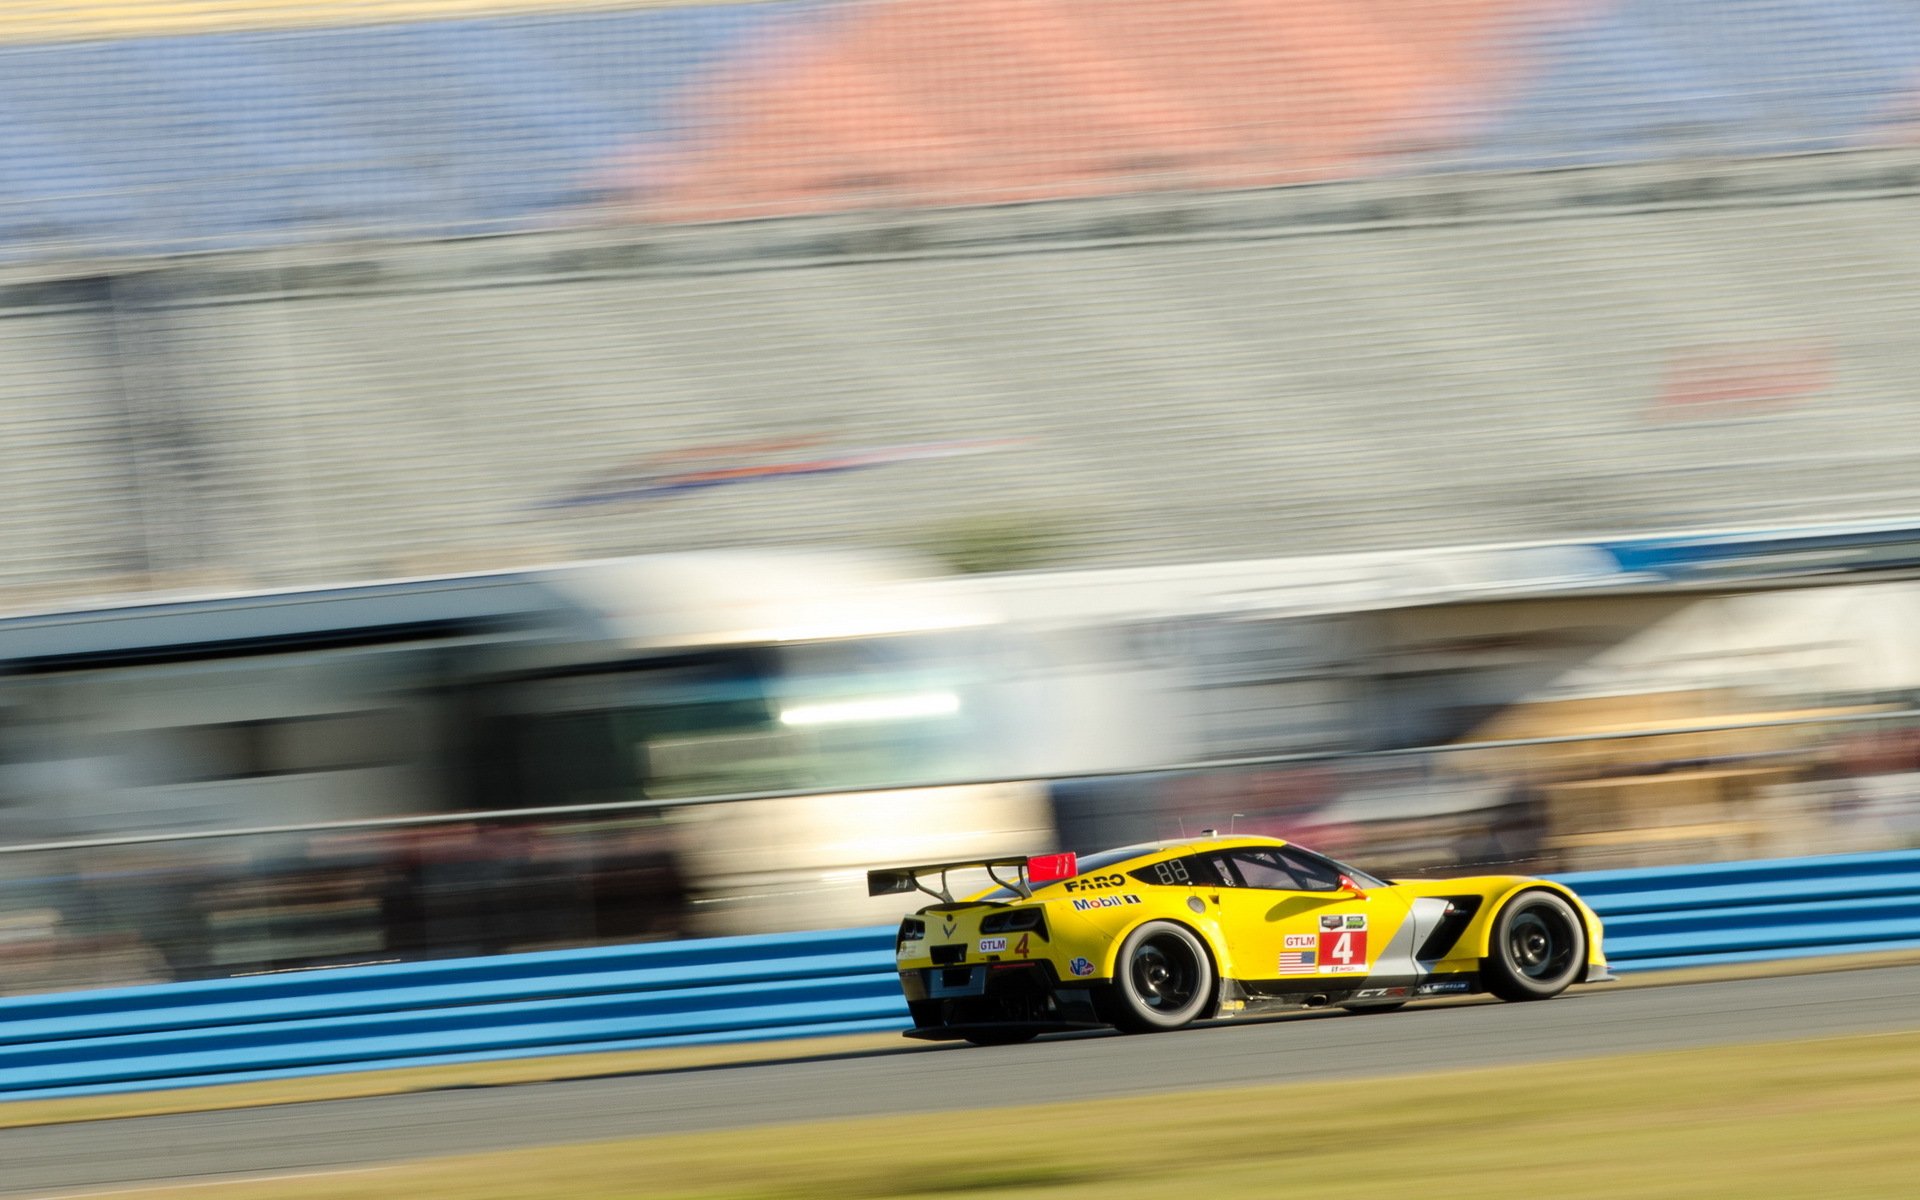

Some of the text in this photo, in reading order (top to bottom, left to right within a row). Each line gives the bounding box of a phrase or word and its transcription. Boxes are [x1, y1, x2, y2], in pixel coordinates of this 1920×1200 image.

[1064, 873, 1126, 893] FARO
[1073, 895, 1122, 911] Mobil
[980, 939, 1006, 951] GTLM
[1014, 932, 1030, 959] 4
[1285, 936, 1316, 947] GTLM
[1332, 933, 1354, 964] 4
